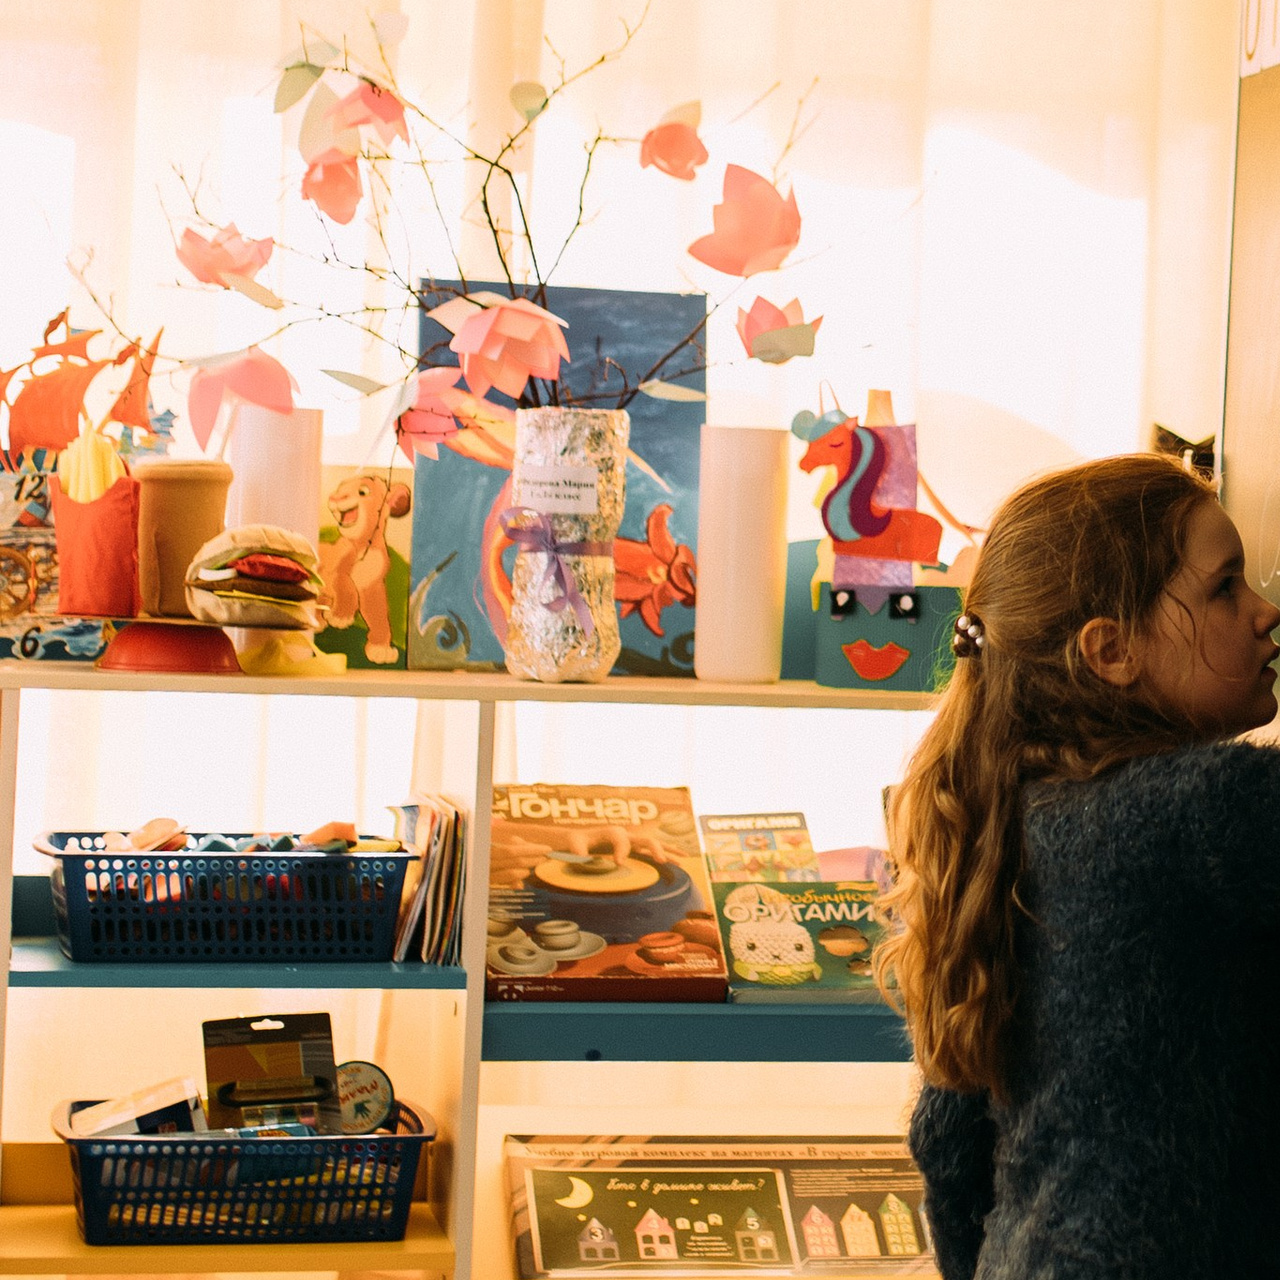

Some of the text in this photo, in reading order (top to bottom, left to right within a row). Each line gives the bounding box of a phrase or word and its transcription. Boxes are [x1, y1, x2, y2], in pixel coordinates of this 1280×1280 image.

[14, 474, 45, 502] 12
[20, 625, 42, 658] 6
[508, 792, 658, 825] Гончар
[762, 889, 873, 905] обычное
[723, 903, 876, 924] ОРИГАМИ
[747, 1217, 760, 1230] 5
[590, 1227, 604, 1243] 3
